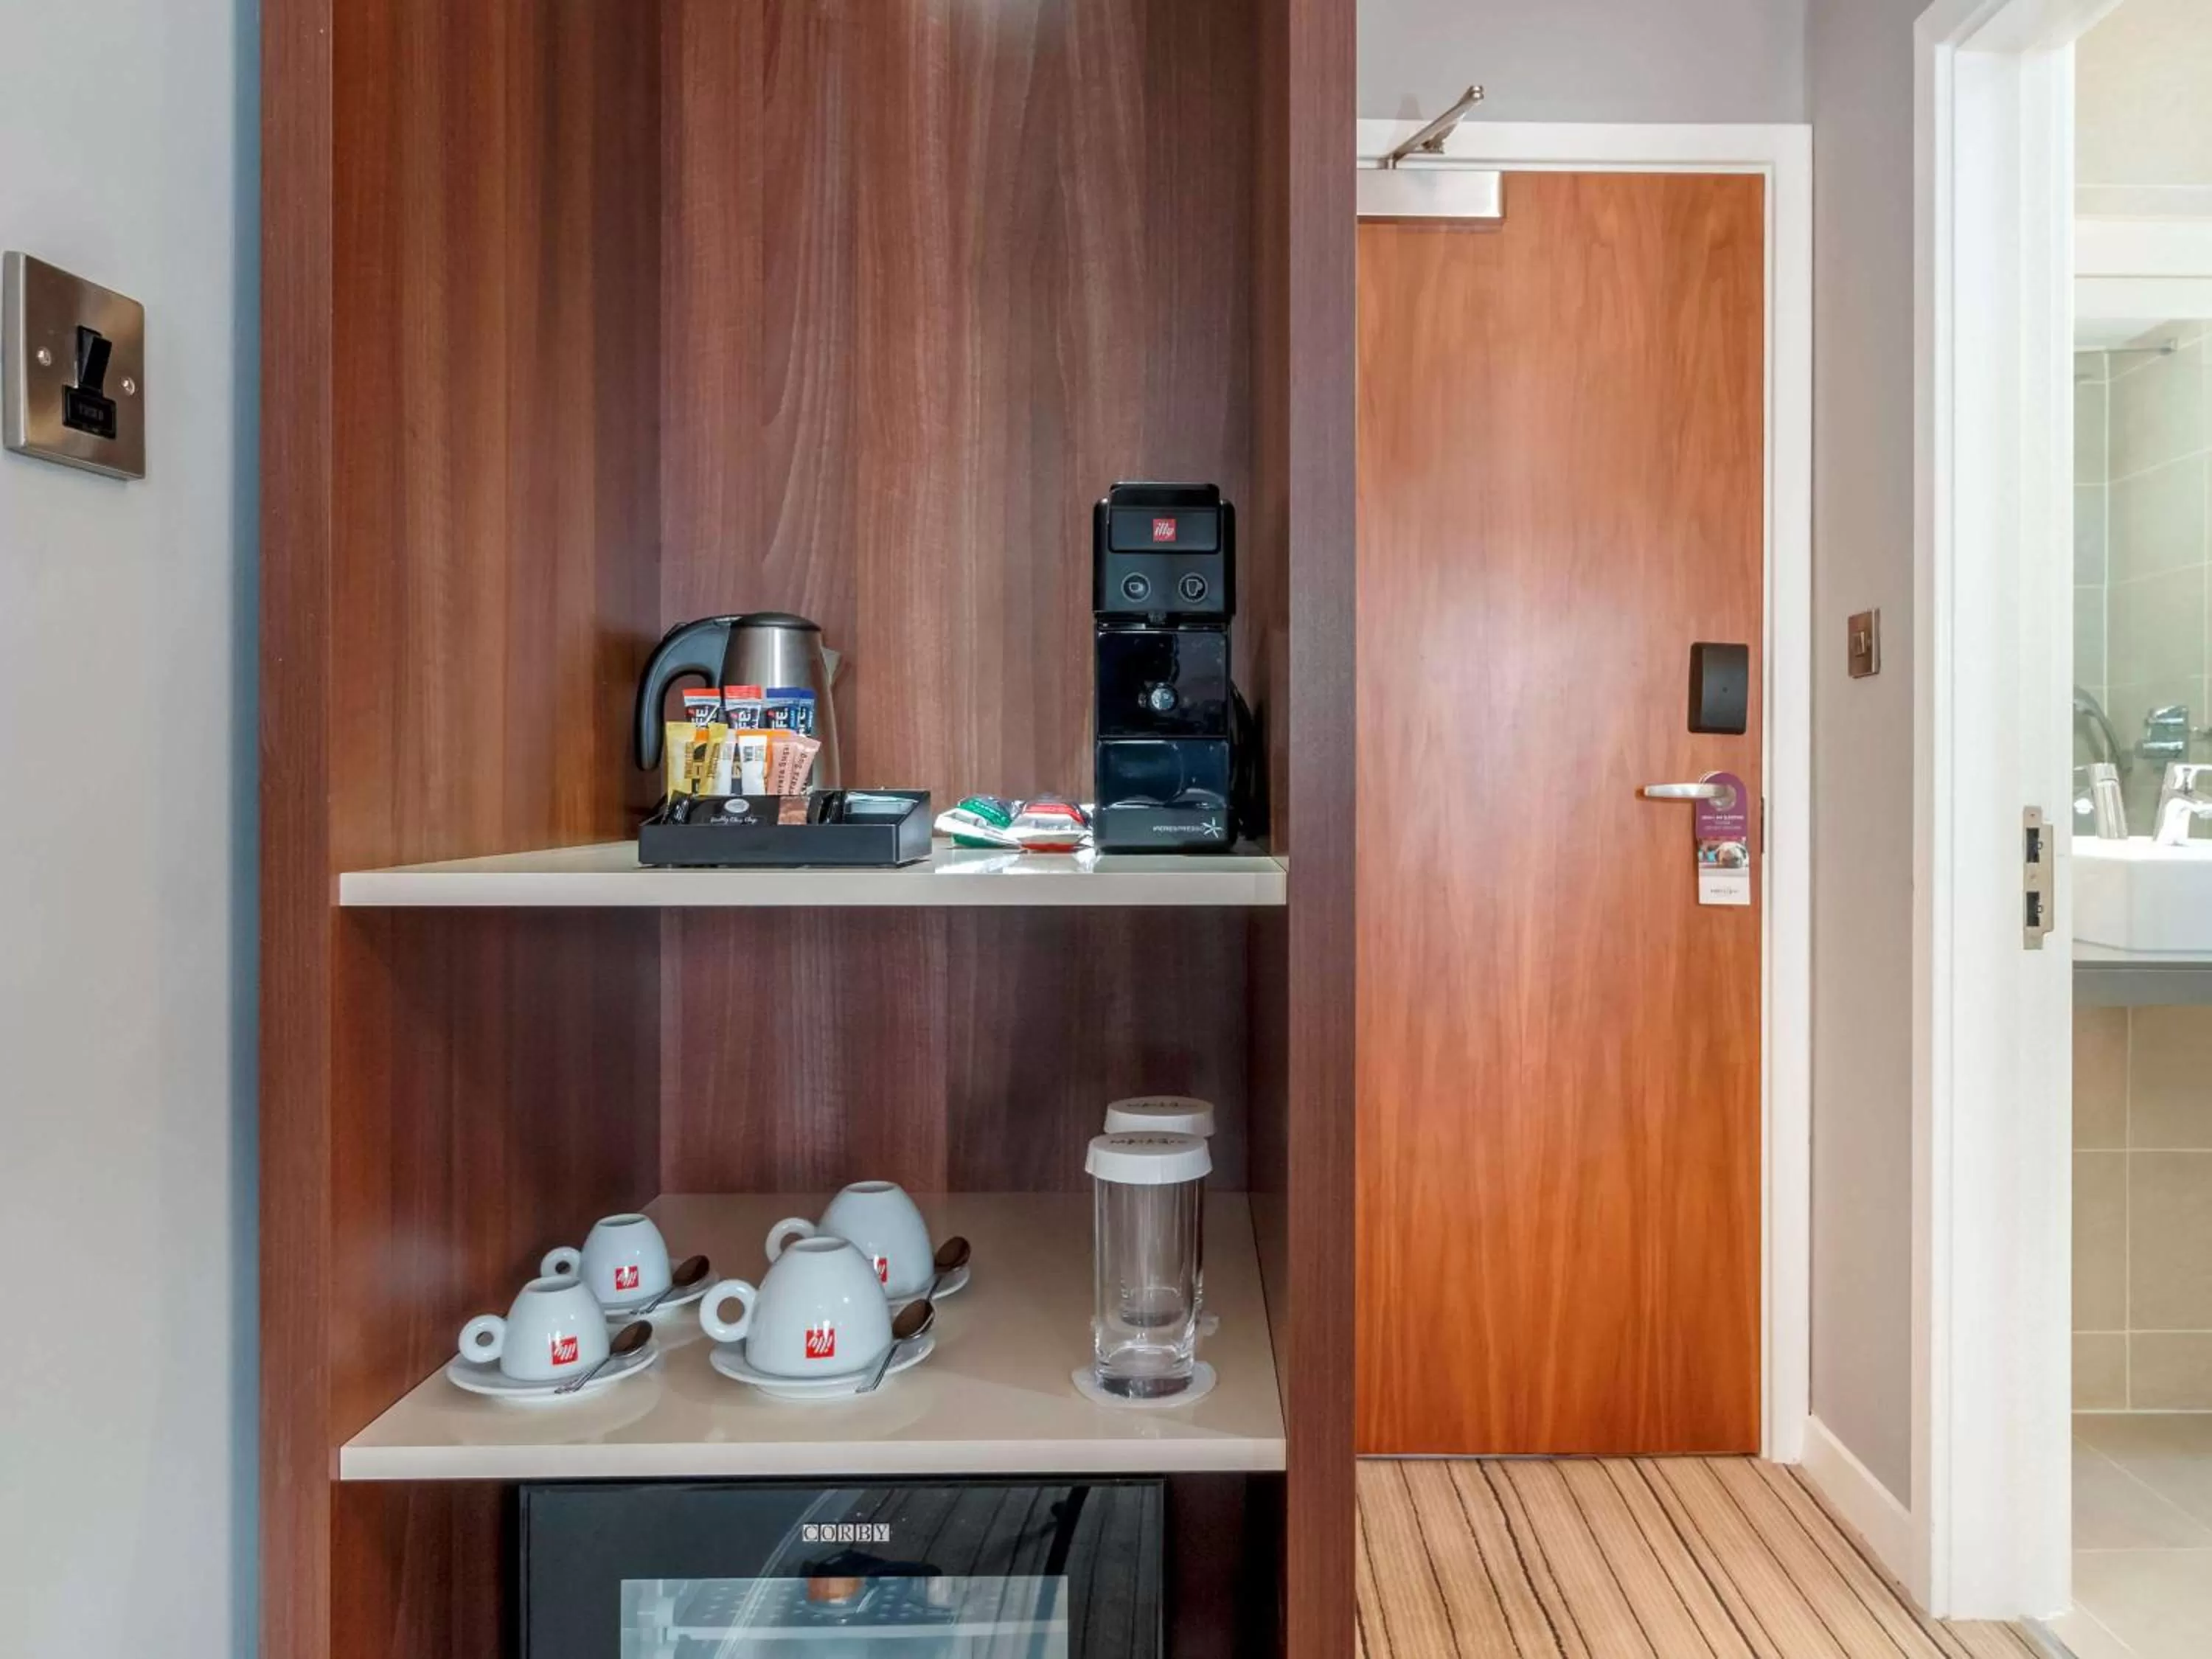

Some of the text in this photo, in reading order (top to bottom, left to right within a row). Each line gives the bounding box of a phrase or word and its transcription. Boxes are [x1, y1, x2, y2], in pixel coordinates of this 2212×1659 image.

[554, 1342, 576, 1360] illy
[807, 1333, 832, 1354] illy
[802, 1523, 890, 1542] CORBY
